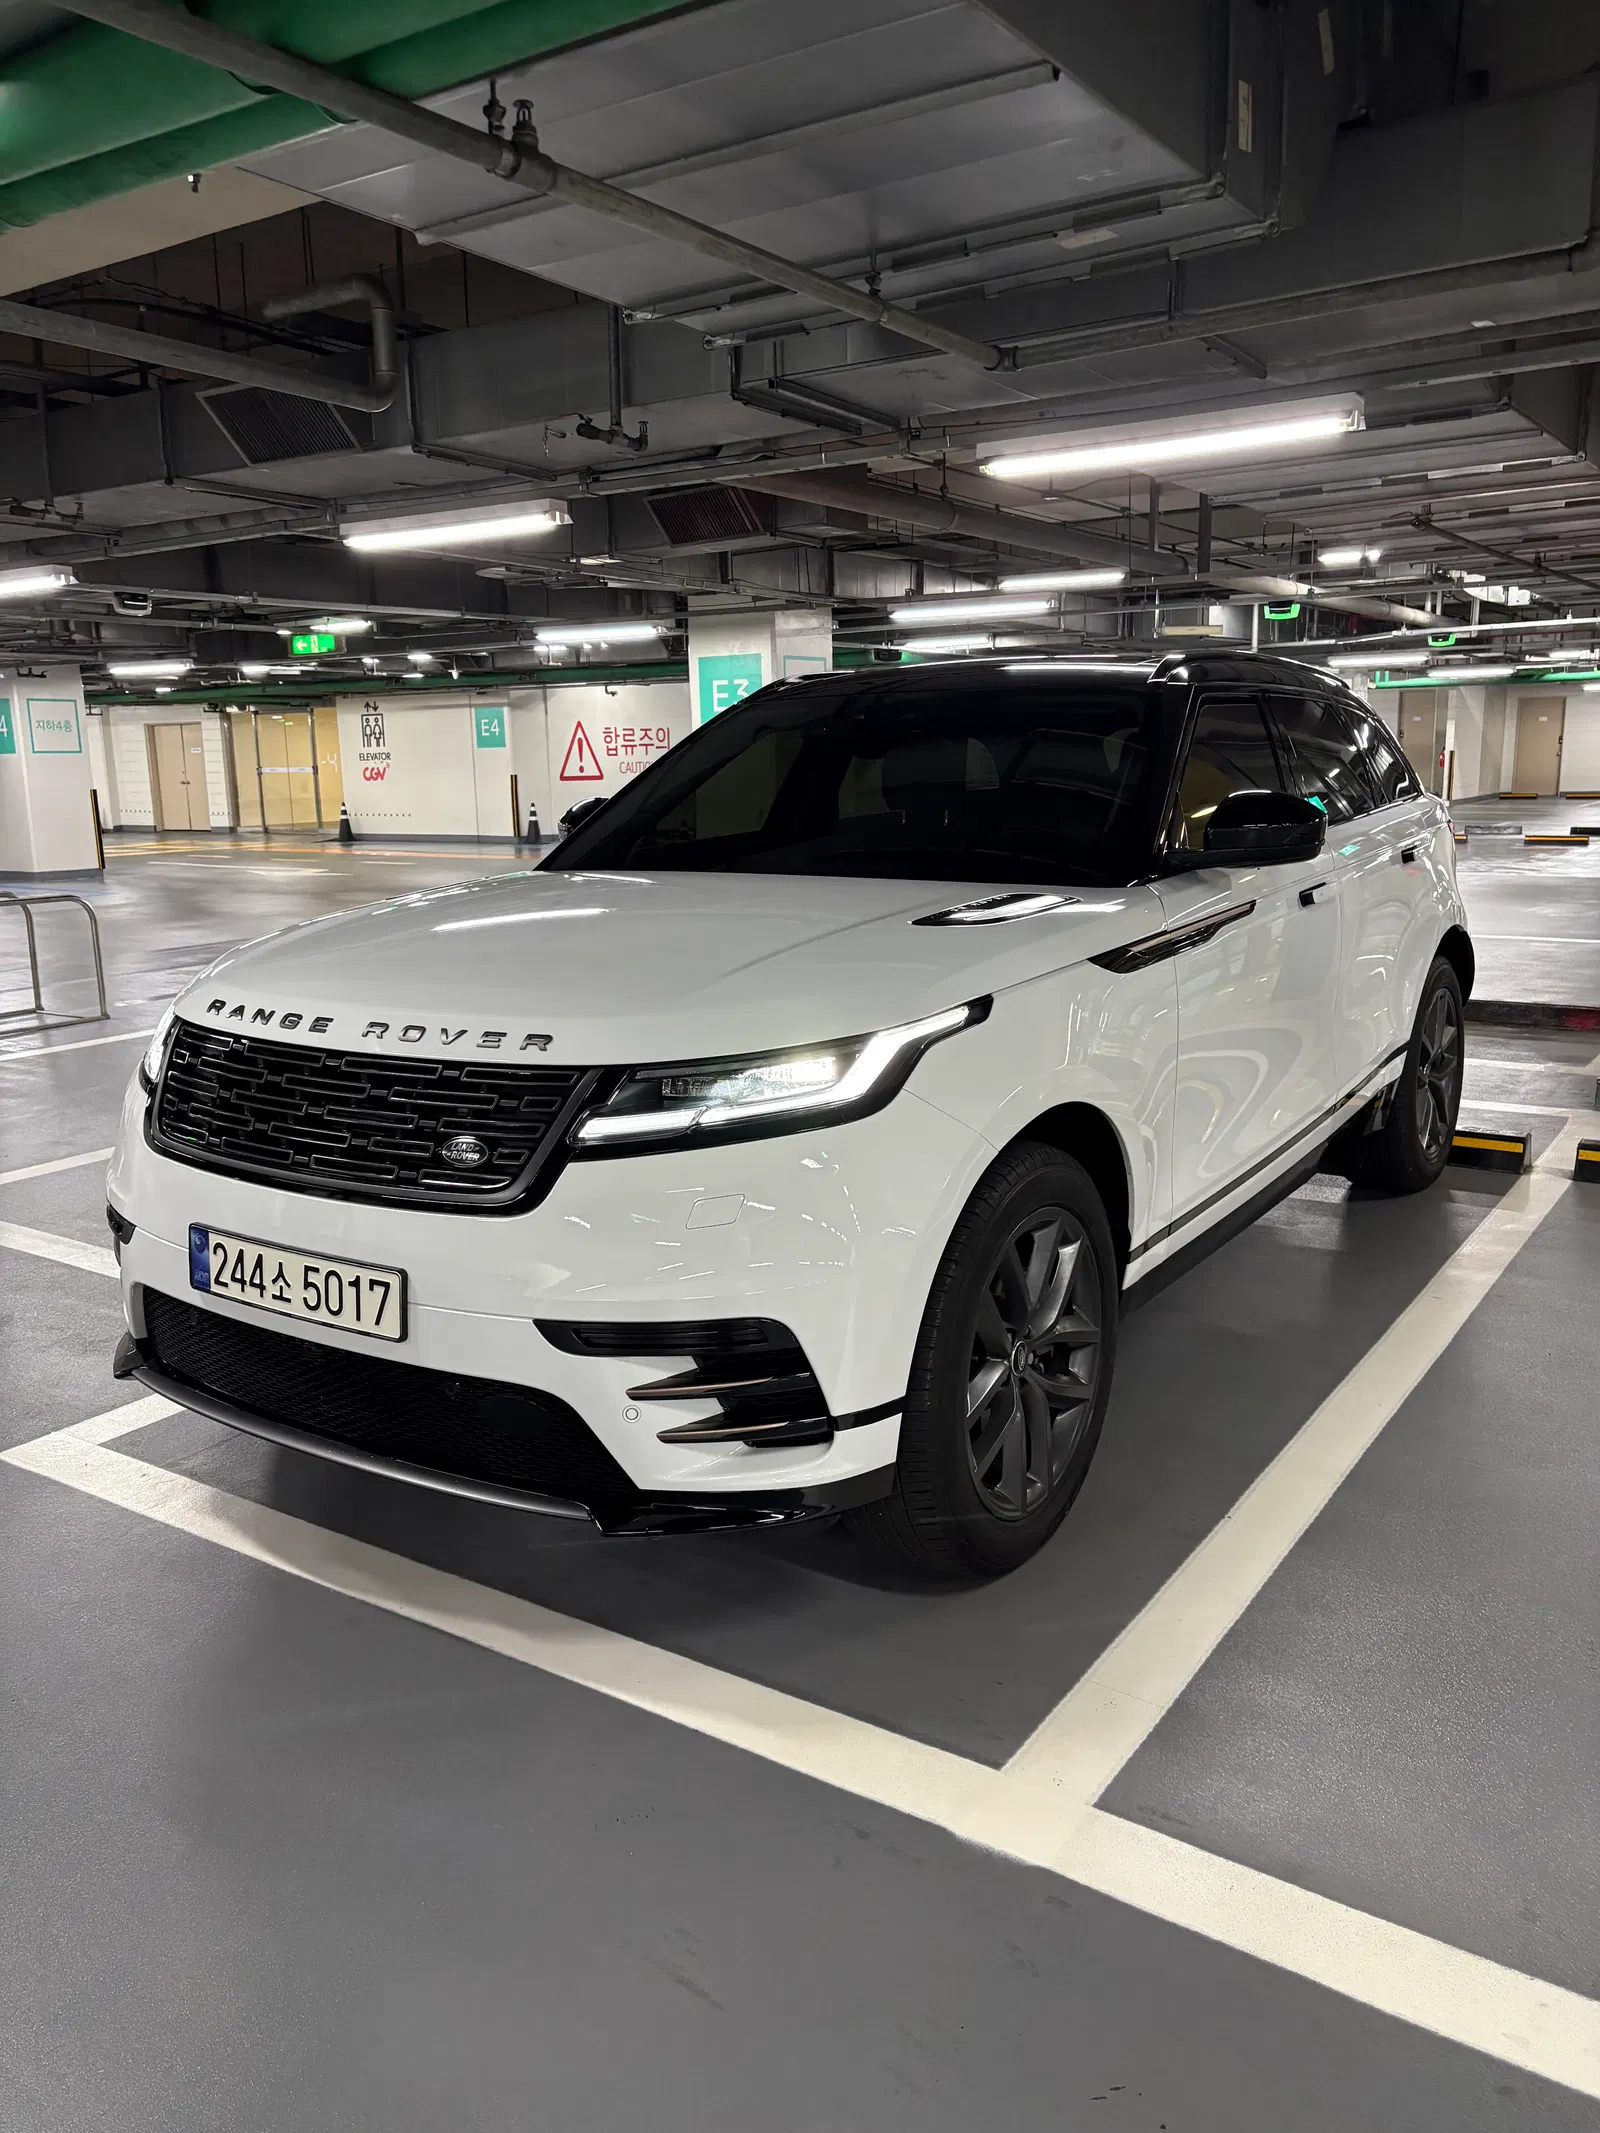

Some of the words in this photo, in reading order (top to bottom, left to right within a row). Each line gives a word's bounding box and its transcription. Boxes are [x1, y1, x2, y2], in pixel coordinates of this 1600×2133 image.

[36, 719, 72, 733] 지하4층
[481, 719, 500, 736] E4
[602, 726, 670, 756] 합류주의
[359, 752, 391, 761] ELEVATOR
[362, 767, 387, 781] CGV
[619, 761, 653, 774] CAUTIO
[206, 998, 335, 1034] RANGE
[361, 1021, 553, 1052] ROVER
[451, 1143, 475, 1151] LAND
[451, 1150, 480, 1161] ROVER
[212, 1241, 292, 1304] 244소
[302, 1263, 391, 1326] 5017
